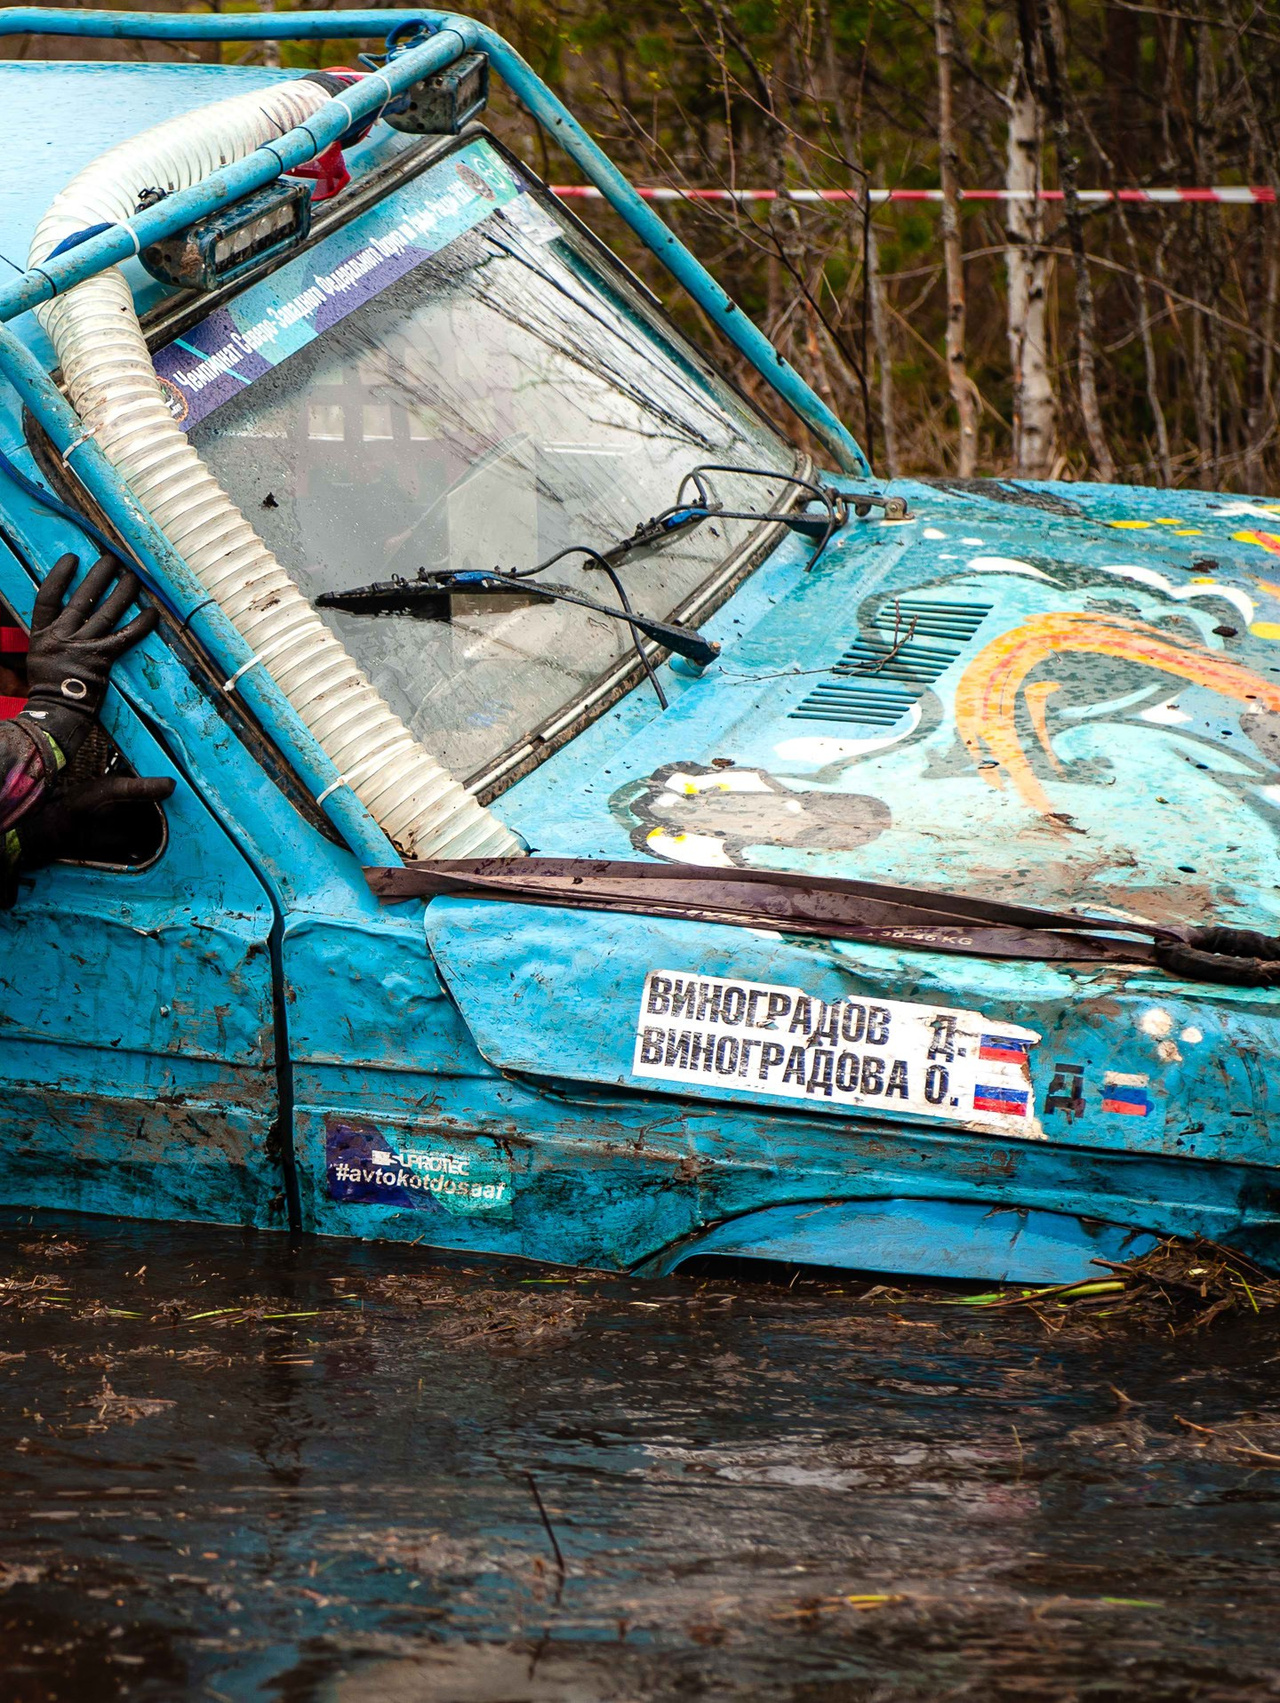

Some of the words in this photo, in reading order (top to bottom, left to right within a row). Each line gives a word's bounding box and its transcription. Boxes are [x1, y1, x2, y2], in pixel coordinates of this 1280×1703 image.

[173, 343, 244, 392] Чемпионат
[230, 285, 328, 353] Северо-Западного
[313, 246, 384, 296] Федерального
[646, 976, 892, 1047] ВИНОГРАДОВ
[927, 1013, 966, 1063] Д.
[639, 1025, 910, 1100] ВИНОГРАДОВА
[924, 1063, 960, 1107] О.
[335, 1163, 507, 1200] #avtokotdosaaf
